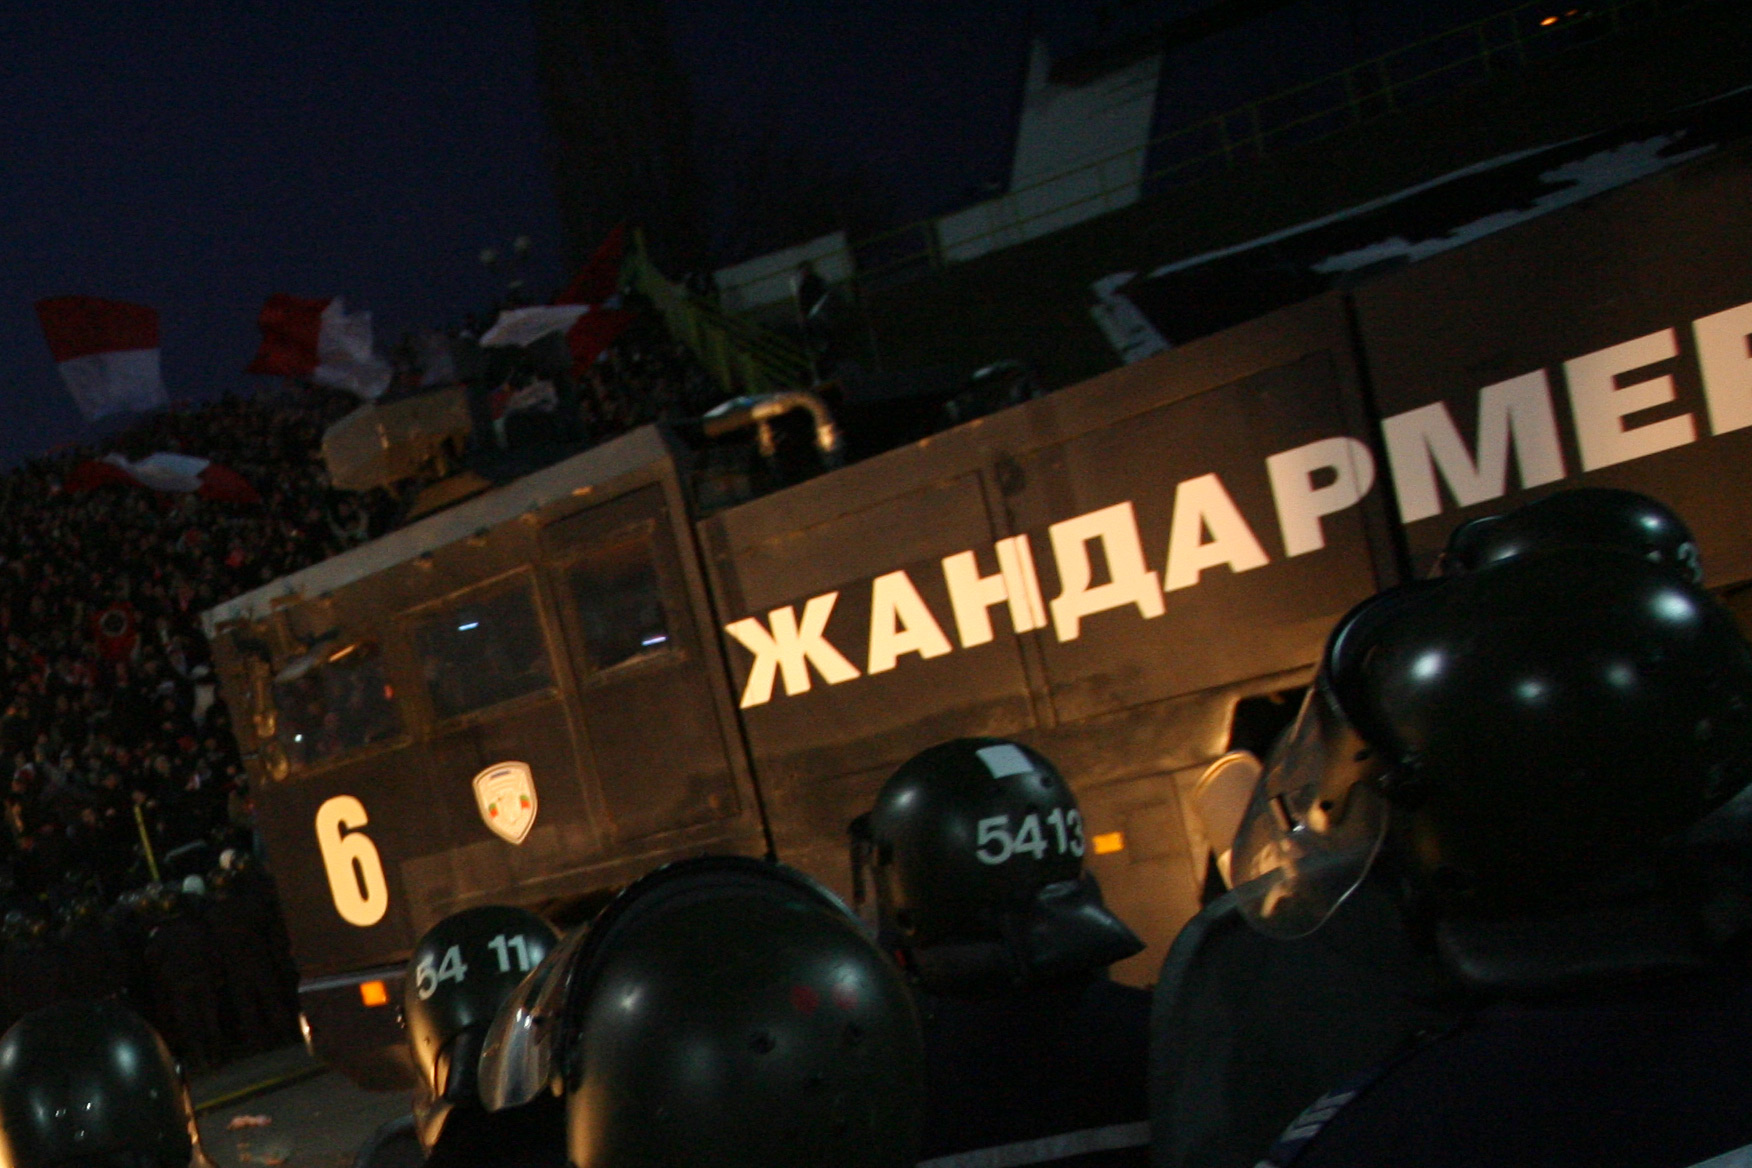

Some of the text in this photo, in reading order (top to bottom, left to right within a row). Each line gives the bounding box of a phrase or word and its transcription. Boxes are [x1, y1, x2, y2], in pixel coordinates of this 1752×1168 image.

[315, 794, 389, 927] 6
[416, 933, 531, 1000] 54 11
